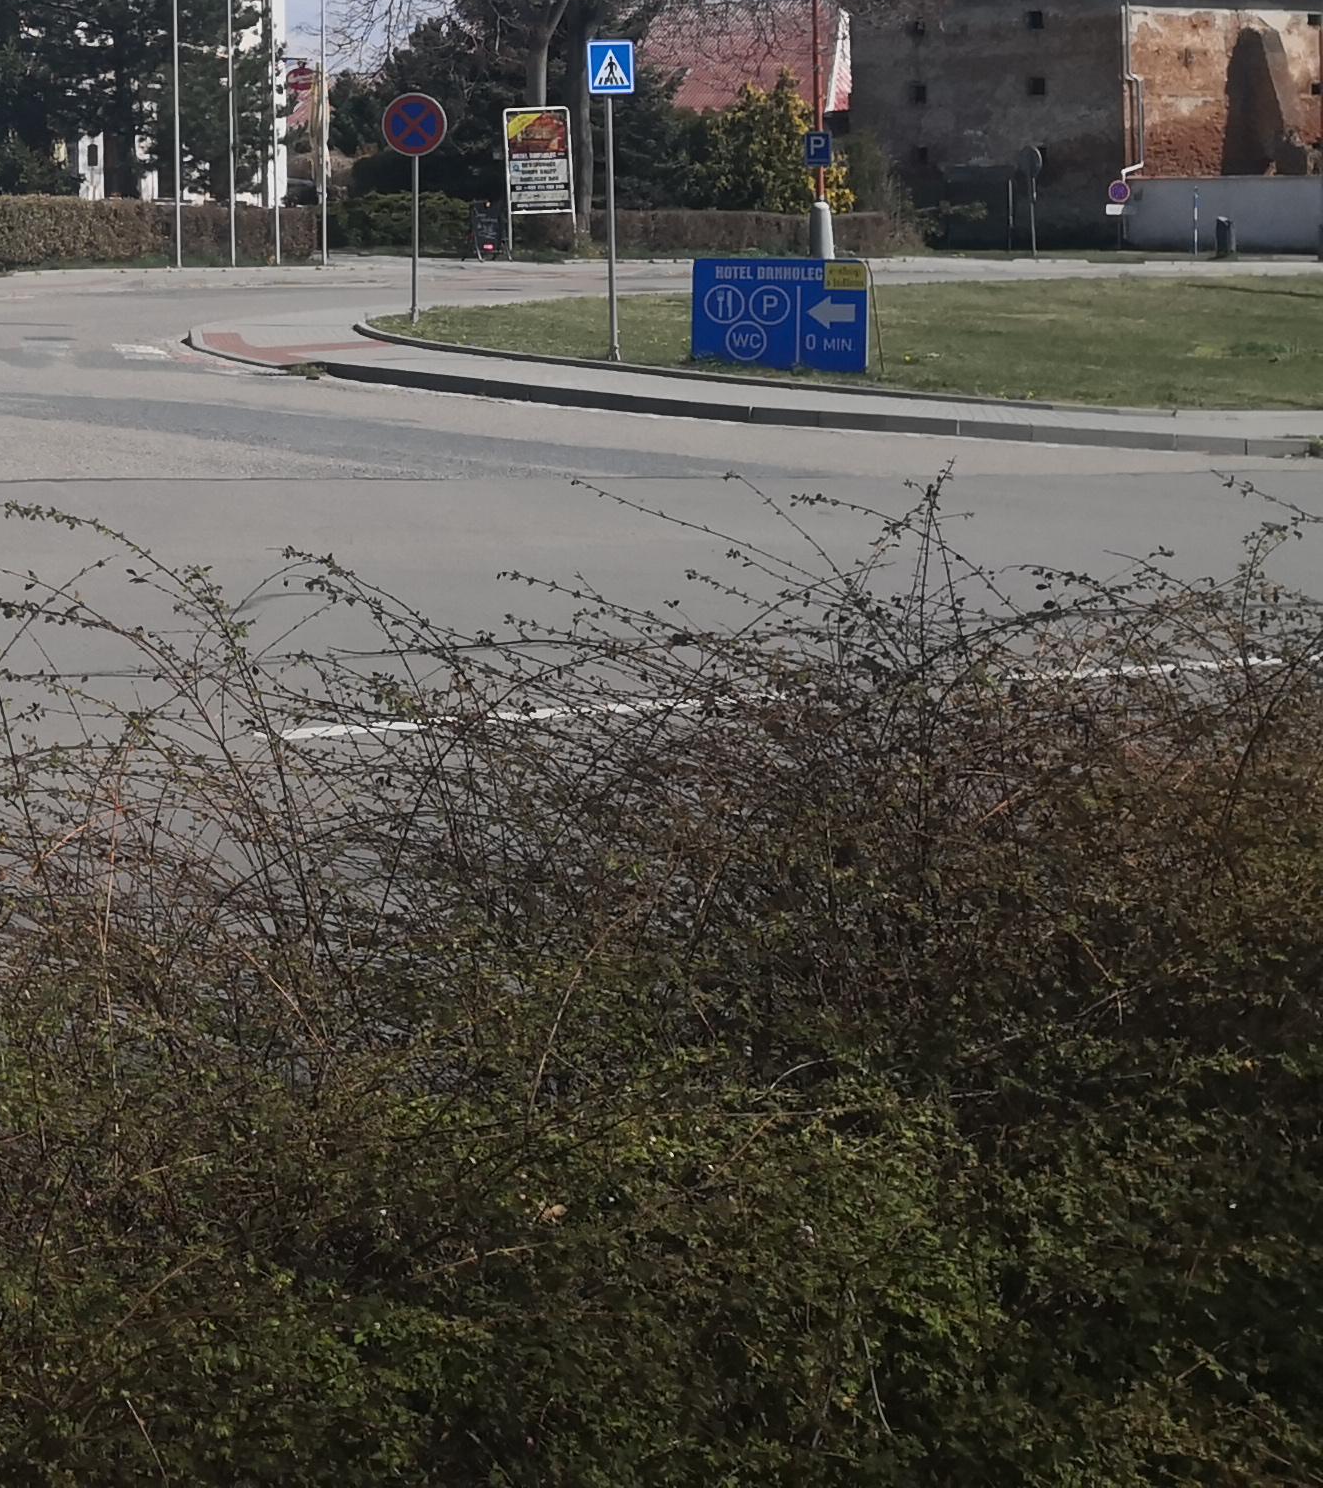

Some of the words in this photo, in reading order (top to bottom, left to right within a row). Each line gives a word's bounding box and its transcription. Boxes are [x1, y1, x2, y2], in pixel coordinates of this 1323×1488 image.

[810, 136, 826, 156] P
[715, 266, 754, 279] HOTEL
[762, 295, 778, 316] P
[732, 332, 761, 348] WC
